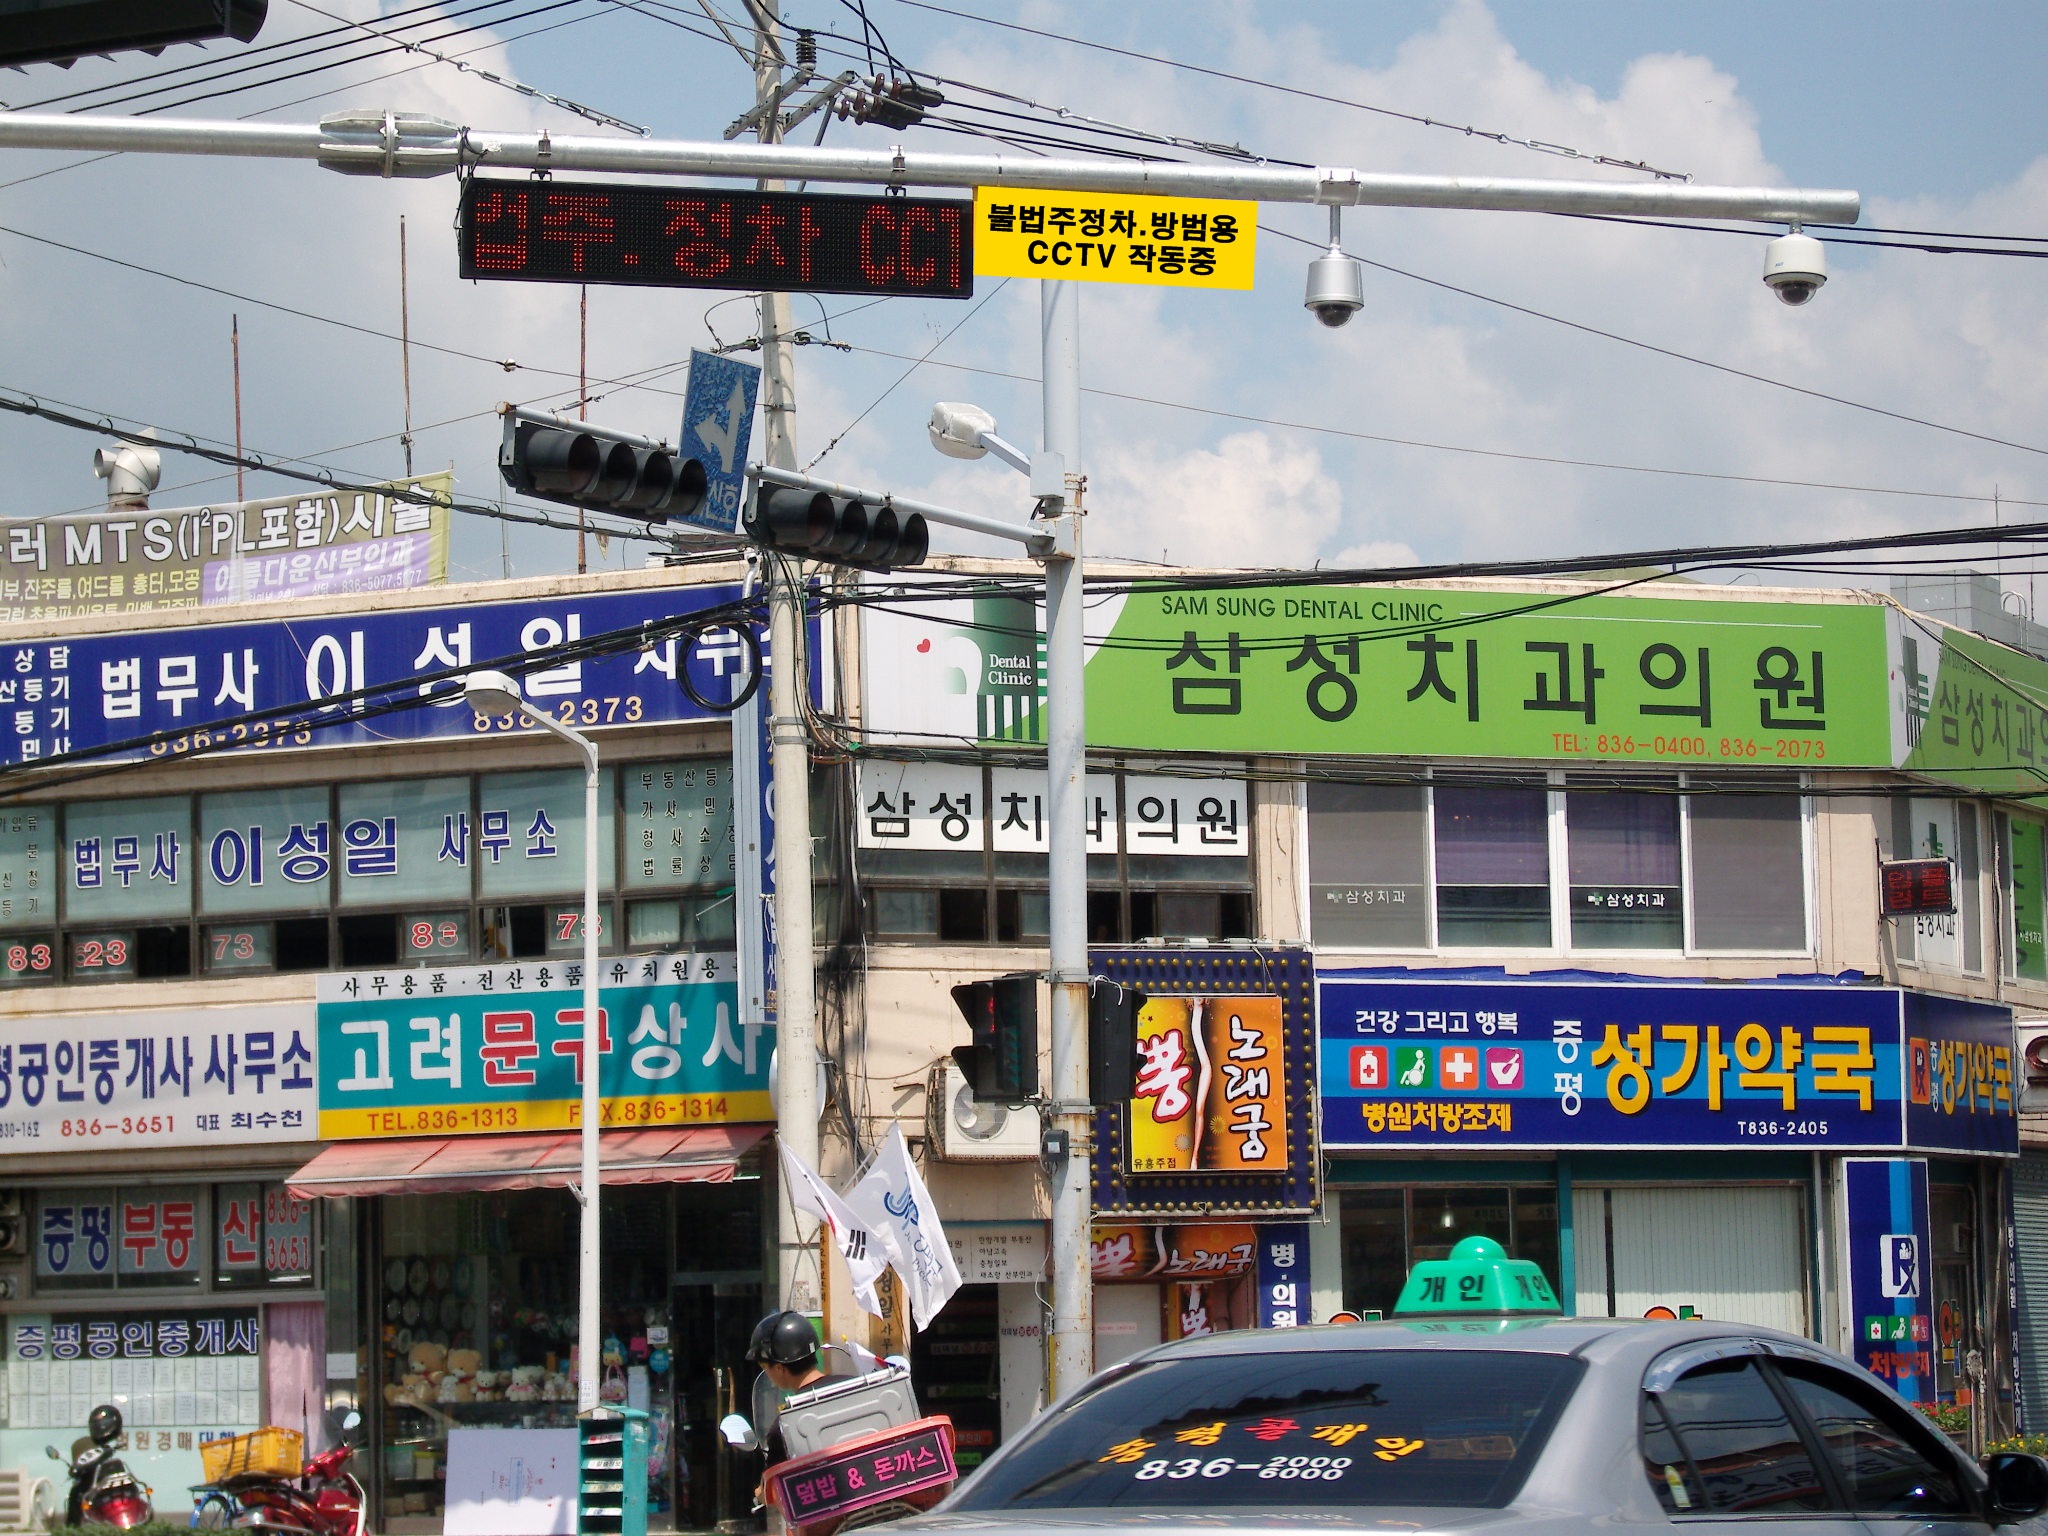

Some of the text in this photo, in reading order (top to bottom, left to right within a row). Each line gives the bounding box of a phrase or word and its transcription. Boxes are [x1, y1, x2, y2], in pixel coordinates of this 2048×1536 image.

[987, 203, 1239, 244] 불법주정차.방범용
[1027, 240, 1217, 276] CCTV 작동중
[0, 523, 48, 571] 러
[0, 575, 124, 601] 부,잔주름,여드름
[1162, 595, 1444, 623] SAM SUNG DENTAL CLINIC
[101, 648, 260, 720] 법무사
[633, 616, 772, 681] 사무
[987, 671, 1032, 687] Clinic
[988, 653, 1032, 670] Dental
[1166, 630, 1827, 731] 삼성치과의원
[1552, 733, 1589, 752] TEL:
[1720, 738, 1826, 760] 836-2073
[74, 808, 559, 889] 법무사 이성일 사무소
[1346, 889, 1406, 905] 삼성치과
[1606, 892, 1666, 909] 삼성치과
[1355, 1010, 1519, 1036] 건강 그리고 행복
[204, 1030, 313, 1095] 사무소
[1552, 1019, 1583, 1117] 증평
[1591, 1023, 1876, 1116] 성가약국
[1938, 1039, 2014, 1117] 성가약국
[1221, 1014, 1272, 1162] 노래궁
[61, 1116, 175, 1137] 836-3651
[196, 1114, 220, 1132] 대표
[230, 1109, 303, 1130] 최수천
[368, 1097, 729, 1132] TEL.836-1313 FX.836-1314
[1362, 1102, 1513, 1133] 병원처방조제
[1737, 1120, 1829, 1136] T836-2405
[1133, 1158, 1177, 1170] 유흥주점
[42, 1200, 261, 1273] 증평 부동산
[266, 1236, 310, 1271] 3651
[1162, 1243, 1253, 1276] 노래궁
[877, 1271, 893, 1319] 성일
[1419, 1274, 1484, 1303] 개인
[1515, 1274, 1548, 1302] 개인
[15, 1318, 259, 1361] 증평공인중개사
[847, 1467, 867, 1490] &
[873, 1446, 937, 1482] 돈까스
